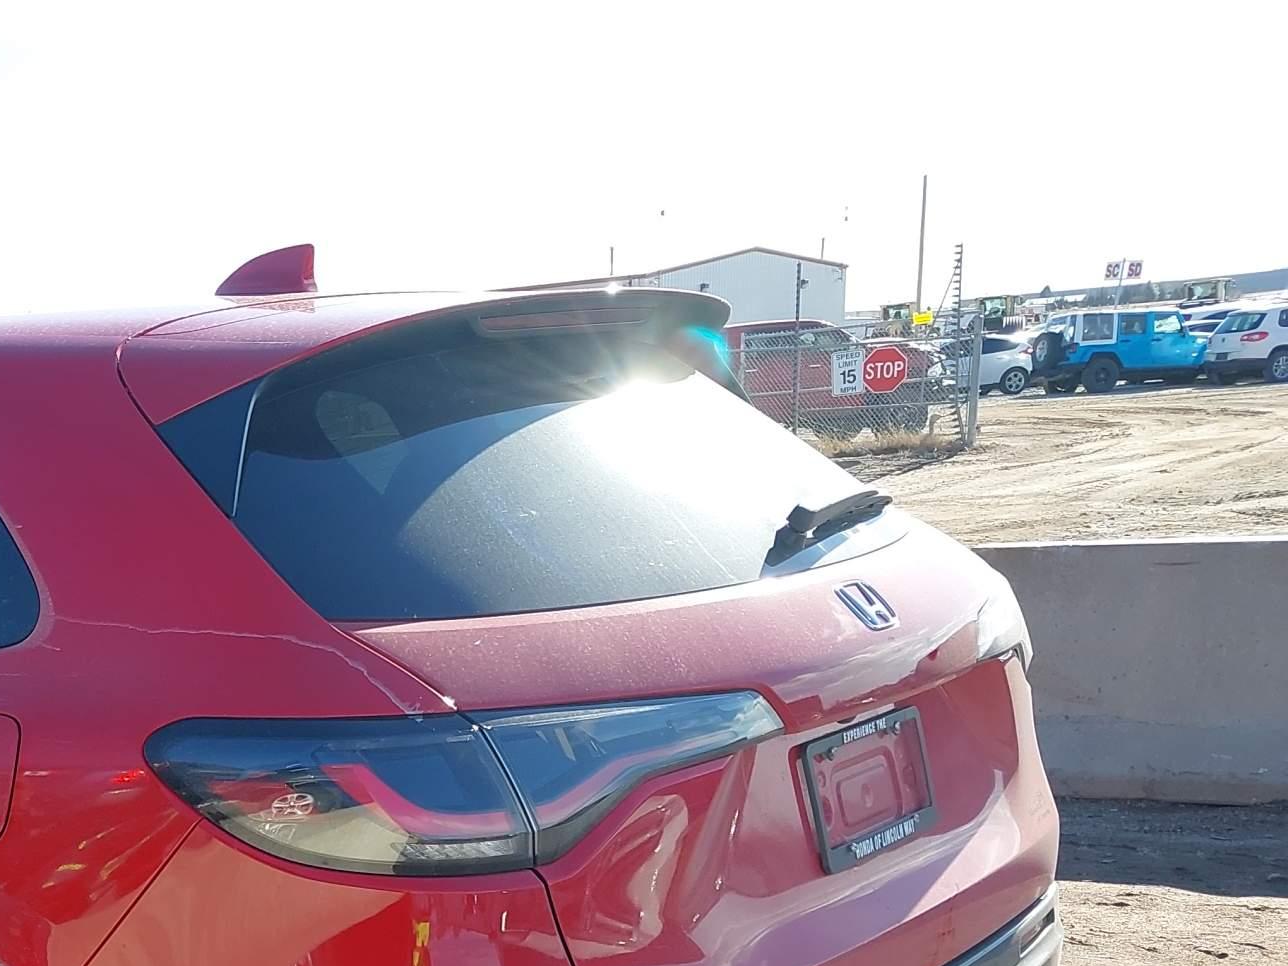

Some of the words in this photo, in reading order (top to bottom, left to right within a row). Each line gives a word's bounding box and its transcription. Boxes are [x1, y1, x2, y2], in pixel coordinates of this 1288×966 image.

[1105, 264, 1120, 278] SC
[1127, 263, 1142, 277] SD
[836, 352, 860, 361] SPEED
[838, 360, 857, 368] LIMIT
[840, 369, 857, 385] 15
[865, 361, 904, 380] STOP
[843, 722, 876, 744] EXPERIENCE
[876, 718, 887, 731] THE
[874, 833, 882, 850] OF
[881, 823, 904, 847] LINCOLN
[903, 819, 915, 836] WAY
